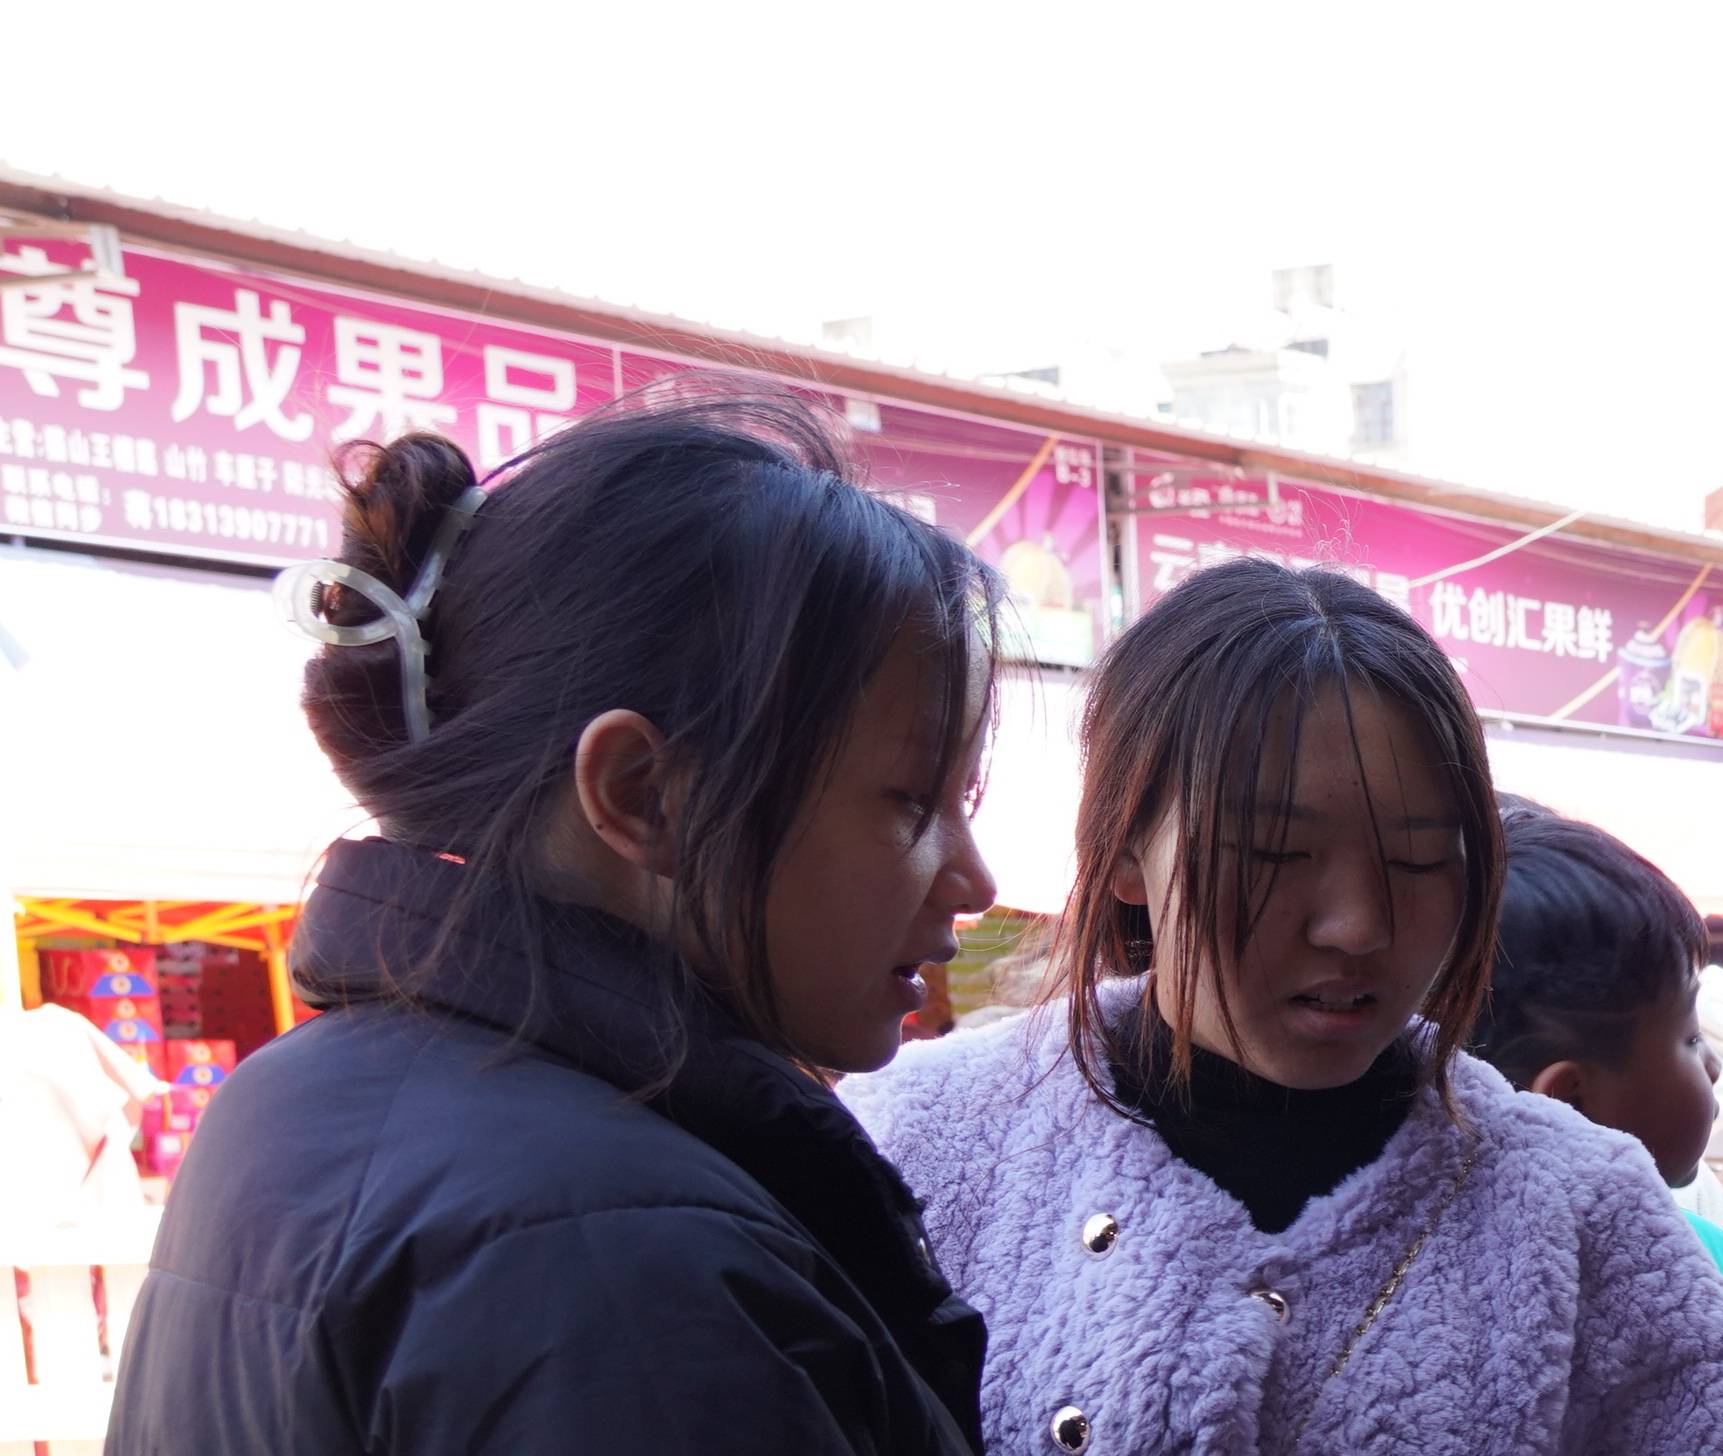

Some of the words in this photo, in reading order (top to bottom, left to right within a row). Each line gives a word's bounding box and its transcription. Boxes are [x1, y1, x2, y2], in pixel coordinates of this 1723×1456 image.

[1429, 580, 1614, 664] 优创汇果鲜
